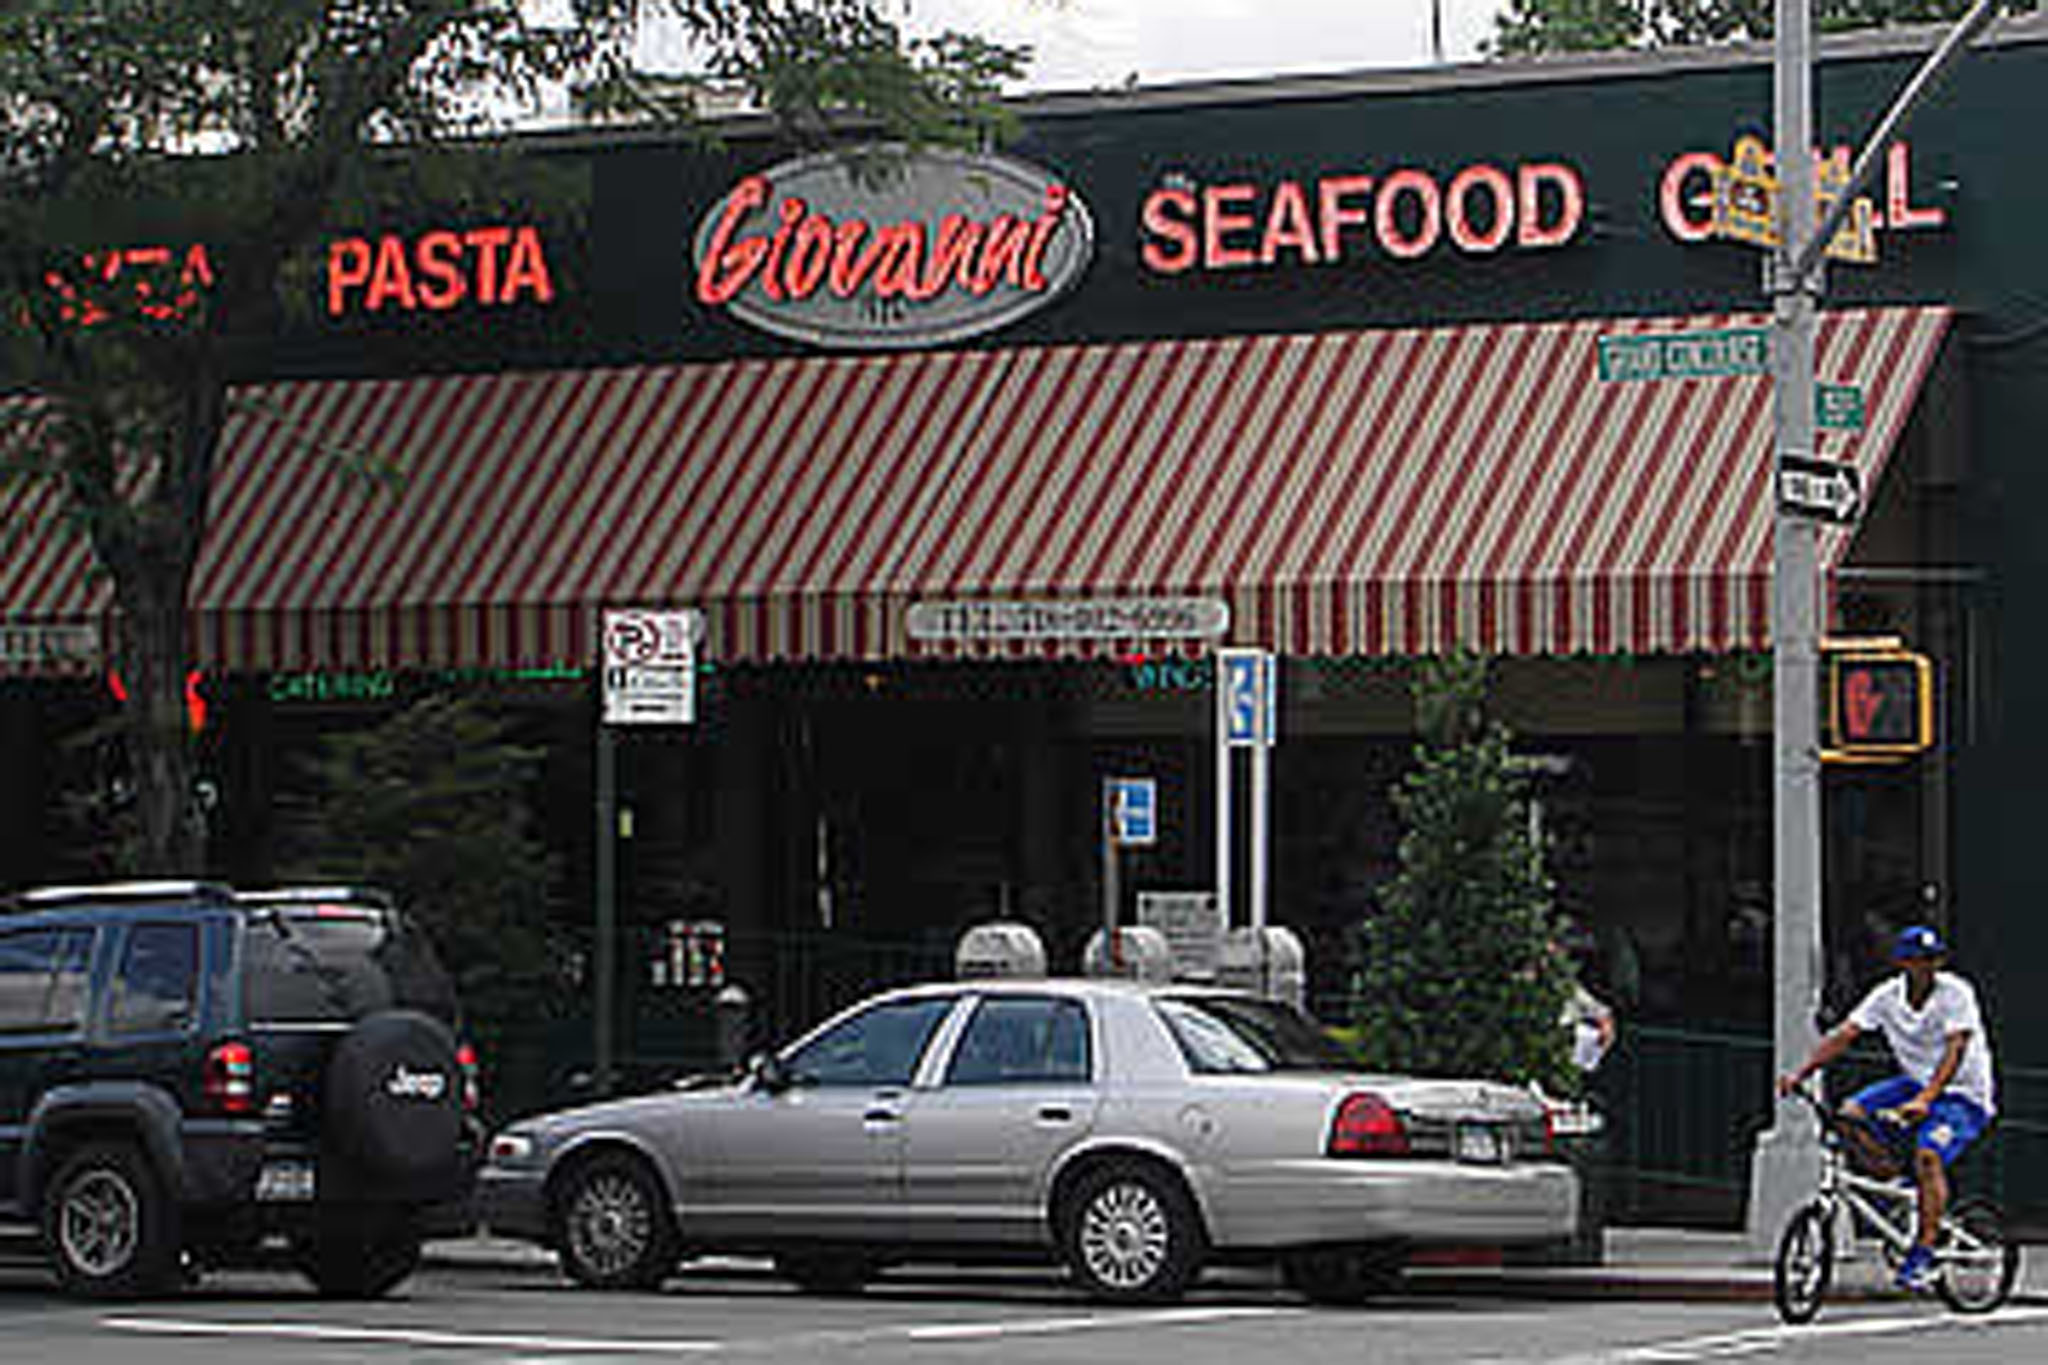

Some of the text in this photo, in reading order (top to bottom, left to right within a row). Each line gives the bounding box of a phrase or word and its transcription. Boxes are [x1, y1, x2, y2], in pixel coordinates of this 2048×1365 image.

[695, 175, 1067, 304] Giovanni
[1142, 163, 1583, 273] SEAFOOD
[328, 226, 554, 316] PASTA
[386, 1064, 446, 1099] Jeep
